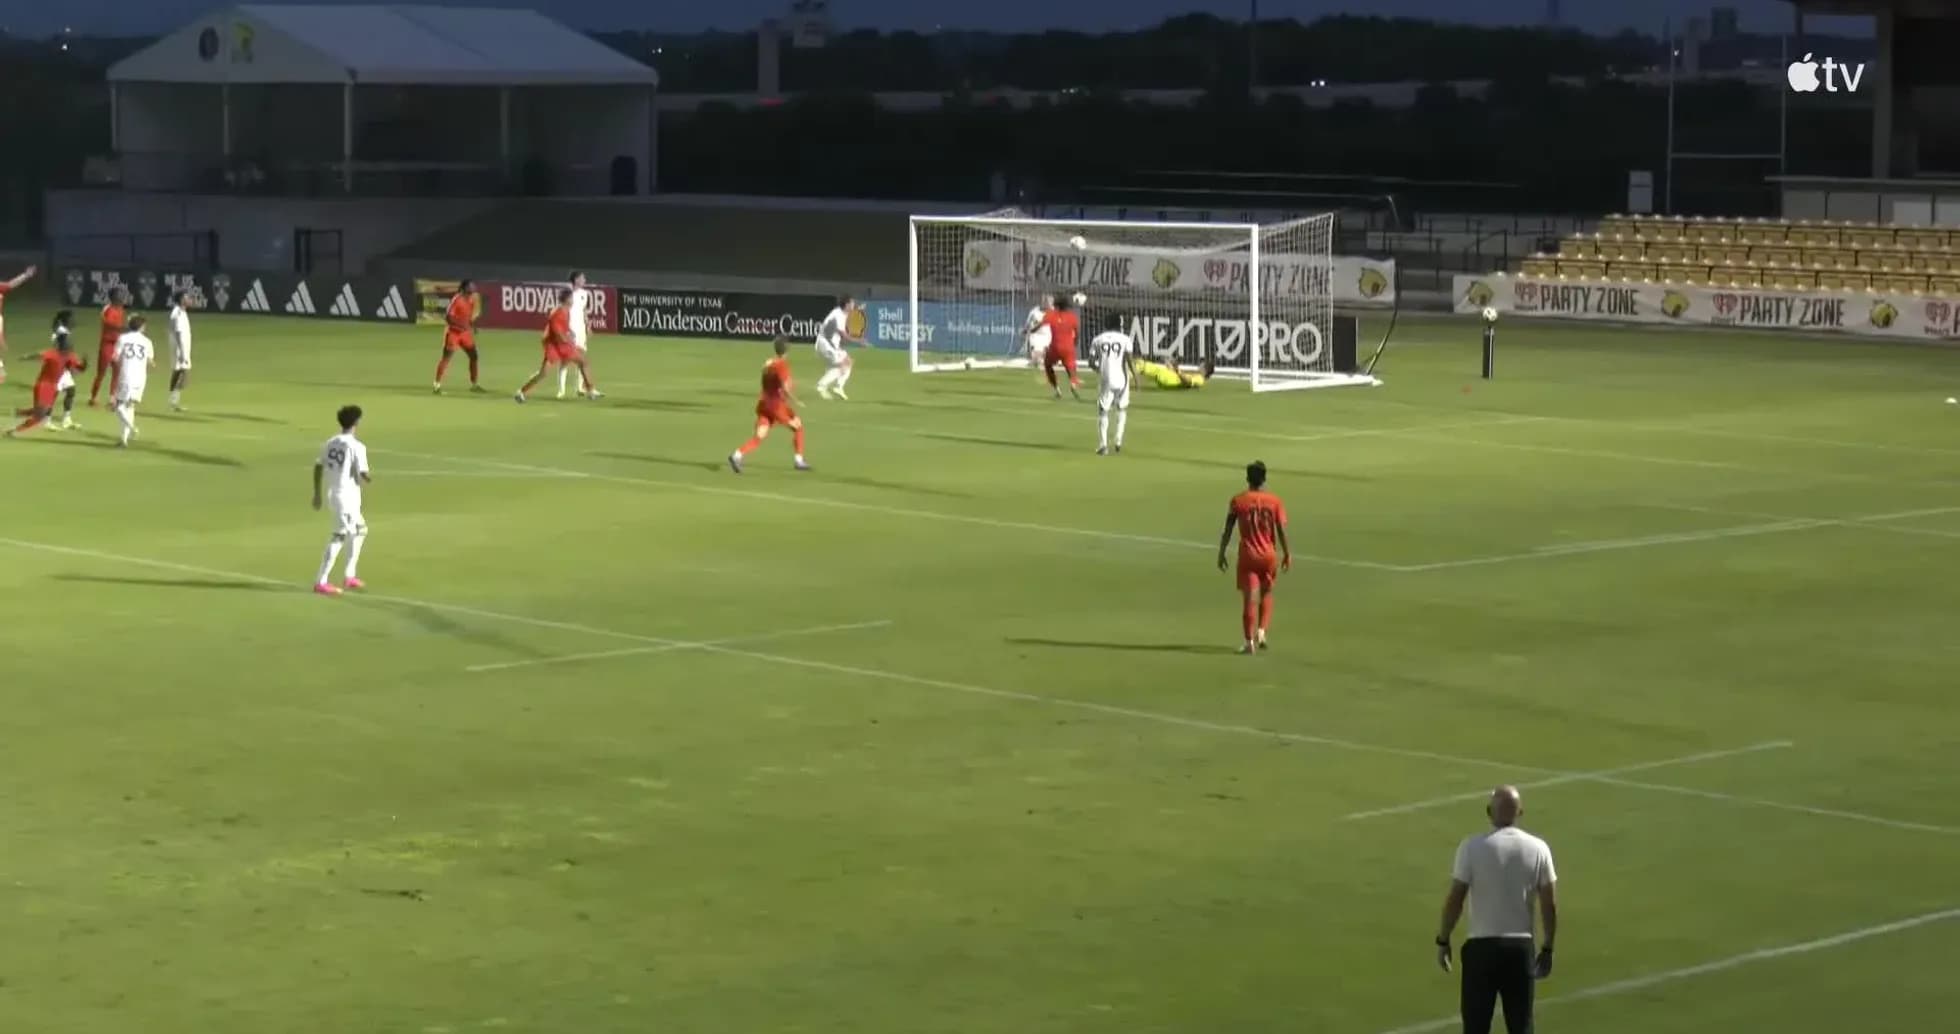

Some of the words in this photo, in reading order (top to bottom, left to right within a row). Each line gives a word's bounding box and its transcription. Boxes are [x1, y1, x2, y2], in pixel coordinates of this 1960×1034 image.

[1034, 252, 1088, 286] PARTY
[1089, 255, 1134, 287] ZONE
[623, 294, 637, 304] THE
[639, 295, 683, 307] UNIVERSITY
[685, 297, 695, 307] OF
[698, 298, 723, 308] TEXAS
[1540, 283, 1591, 313] PARTY
[1595, 286, 1641, 316] ZONE
[878, 307, 903, 321] Shell
[1739, 294, 1796, 325] PARTY
[1798, 297, 1846, 328] ZONE
[725, 312, 779, 335] Cancer
[124, 342, 145, 360] 33
[1101, 342, 1121, 358] 99
